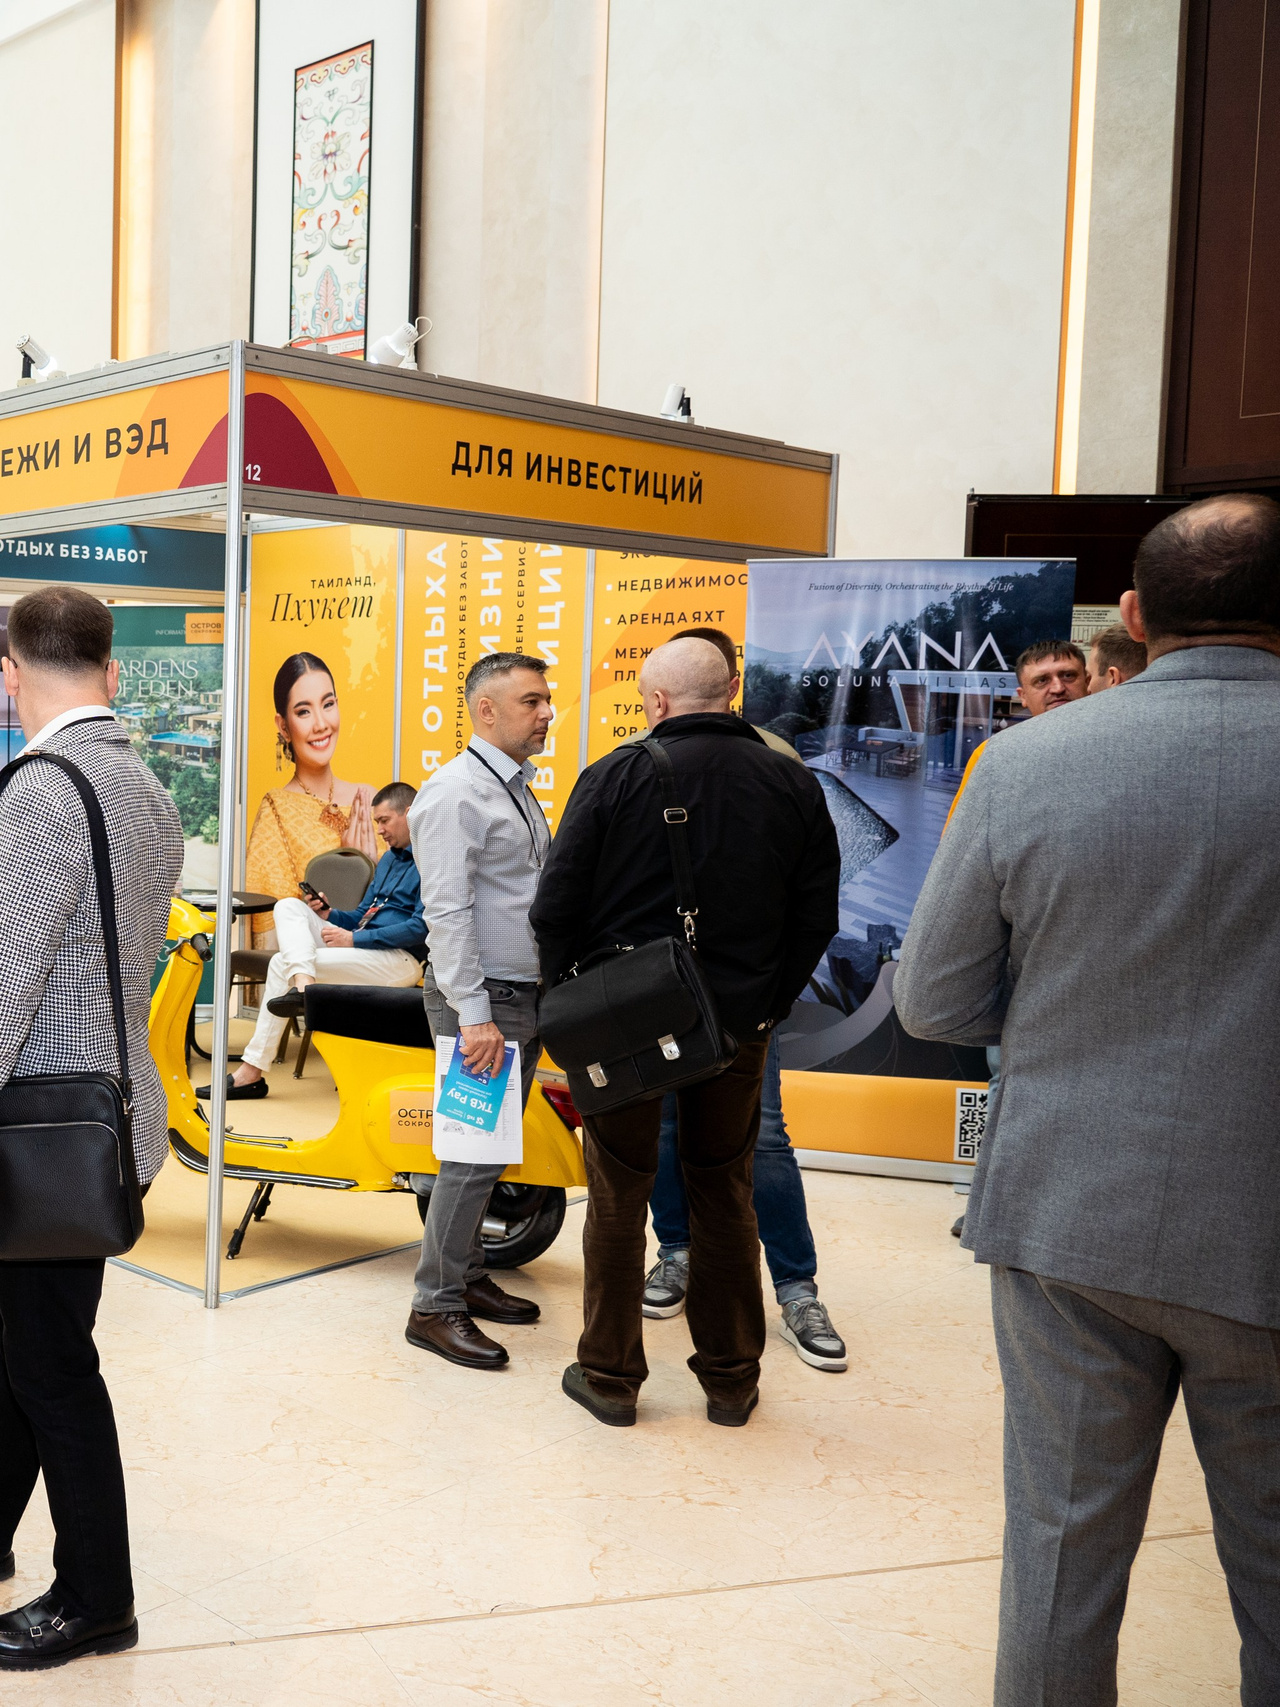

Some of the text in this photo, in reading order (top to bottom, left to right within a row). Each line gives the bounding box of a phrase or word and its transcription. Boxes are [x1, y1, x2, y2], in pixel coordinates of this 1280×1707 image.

[73, 433, 91, 464] И
[105, 417, 169, 459] ВЭД
[244, 463, 261, 481] 12
[452, 440, 704, 505] ДЛЯ ИНВЕСТИЦИЙ
[59, 543, 91, 560] БЕЗ
[94, 546, 148, 564] ЗАБОТ
[459, 540, 469, 589] ЗАБОТ
[311, 576, 376, 589] ТАИЛАНД,
[618, 573, 748, 593] НЕДВИЖИМОС
[808, 582, 835, 591] Fusion
[835, 582, 845, 592] of
[845, 582, 883, 592] Diversity,
[885, 582, 941, 592] Orchestrating
[941, 582, 954, 591] the
[988, 582, 997, 593] of
[997, 582, 1014, 593] Life
[459, 595, 467, 622] БЕЗ
[479, 538, 504, 660] ИЗНИ
[269, 593, 374, 627] Пхукет
[617, 610, 726, 626] АРЕНДА ЯХТ
[422, 541, 449, 732] ОТДЫХА
[457, 627, 467, 680] ОТДЫХ
[802, 630, 1009, 671] AYANA
[118, 658, 199, 679] ARDENS
[139, 680, 194, 700] EDEN
[802, 675, 1008, 689] SOLUNA VILLAS
[447, 1087, 468, 1104] Pay
[470, 1097, 493, 1114] TKB
[398, 1108, 433, 1119] ОСТР
